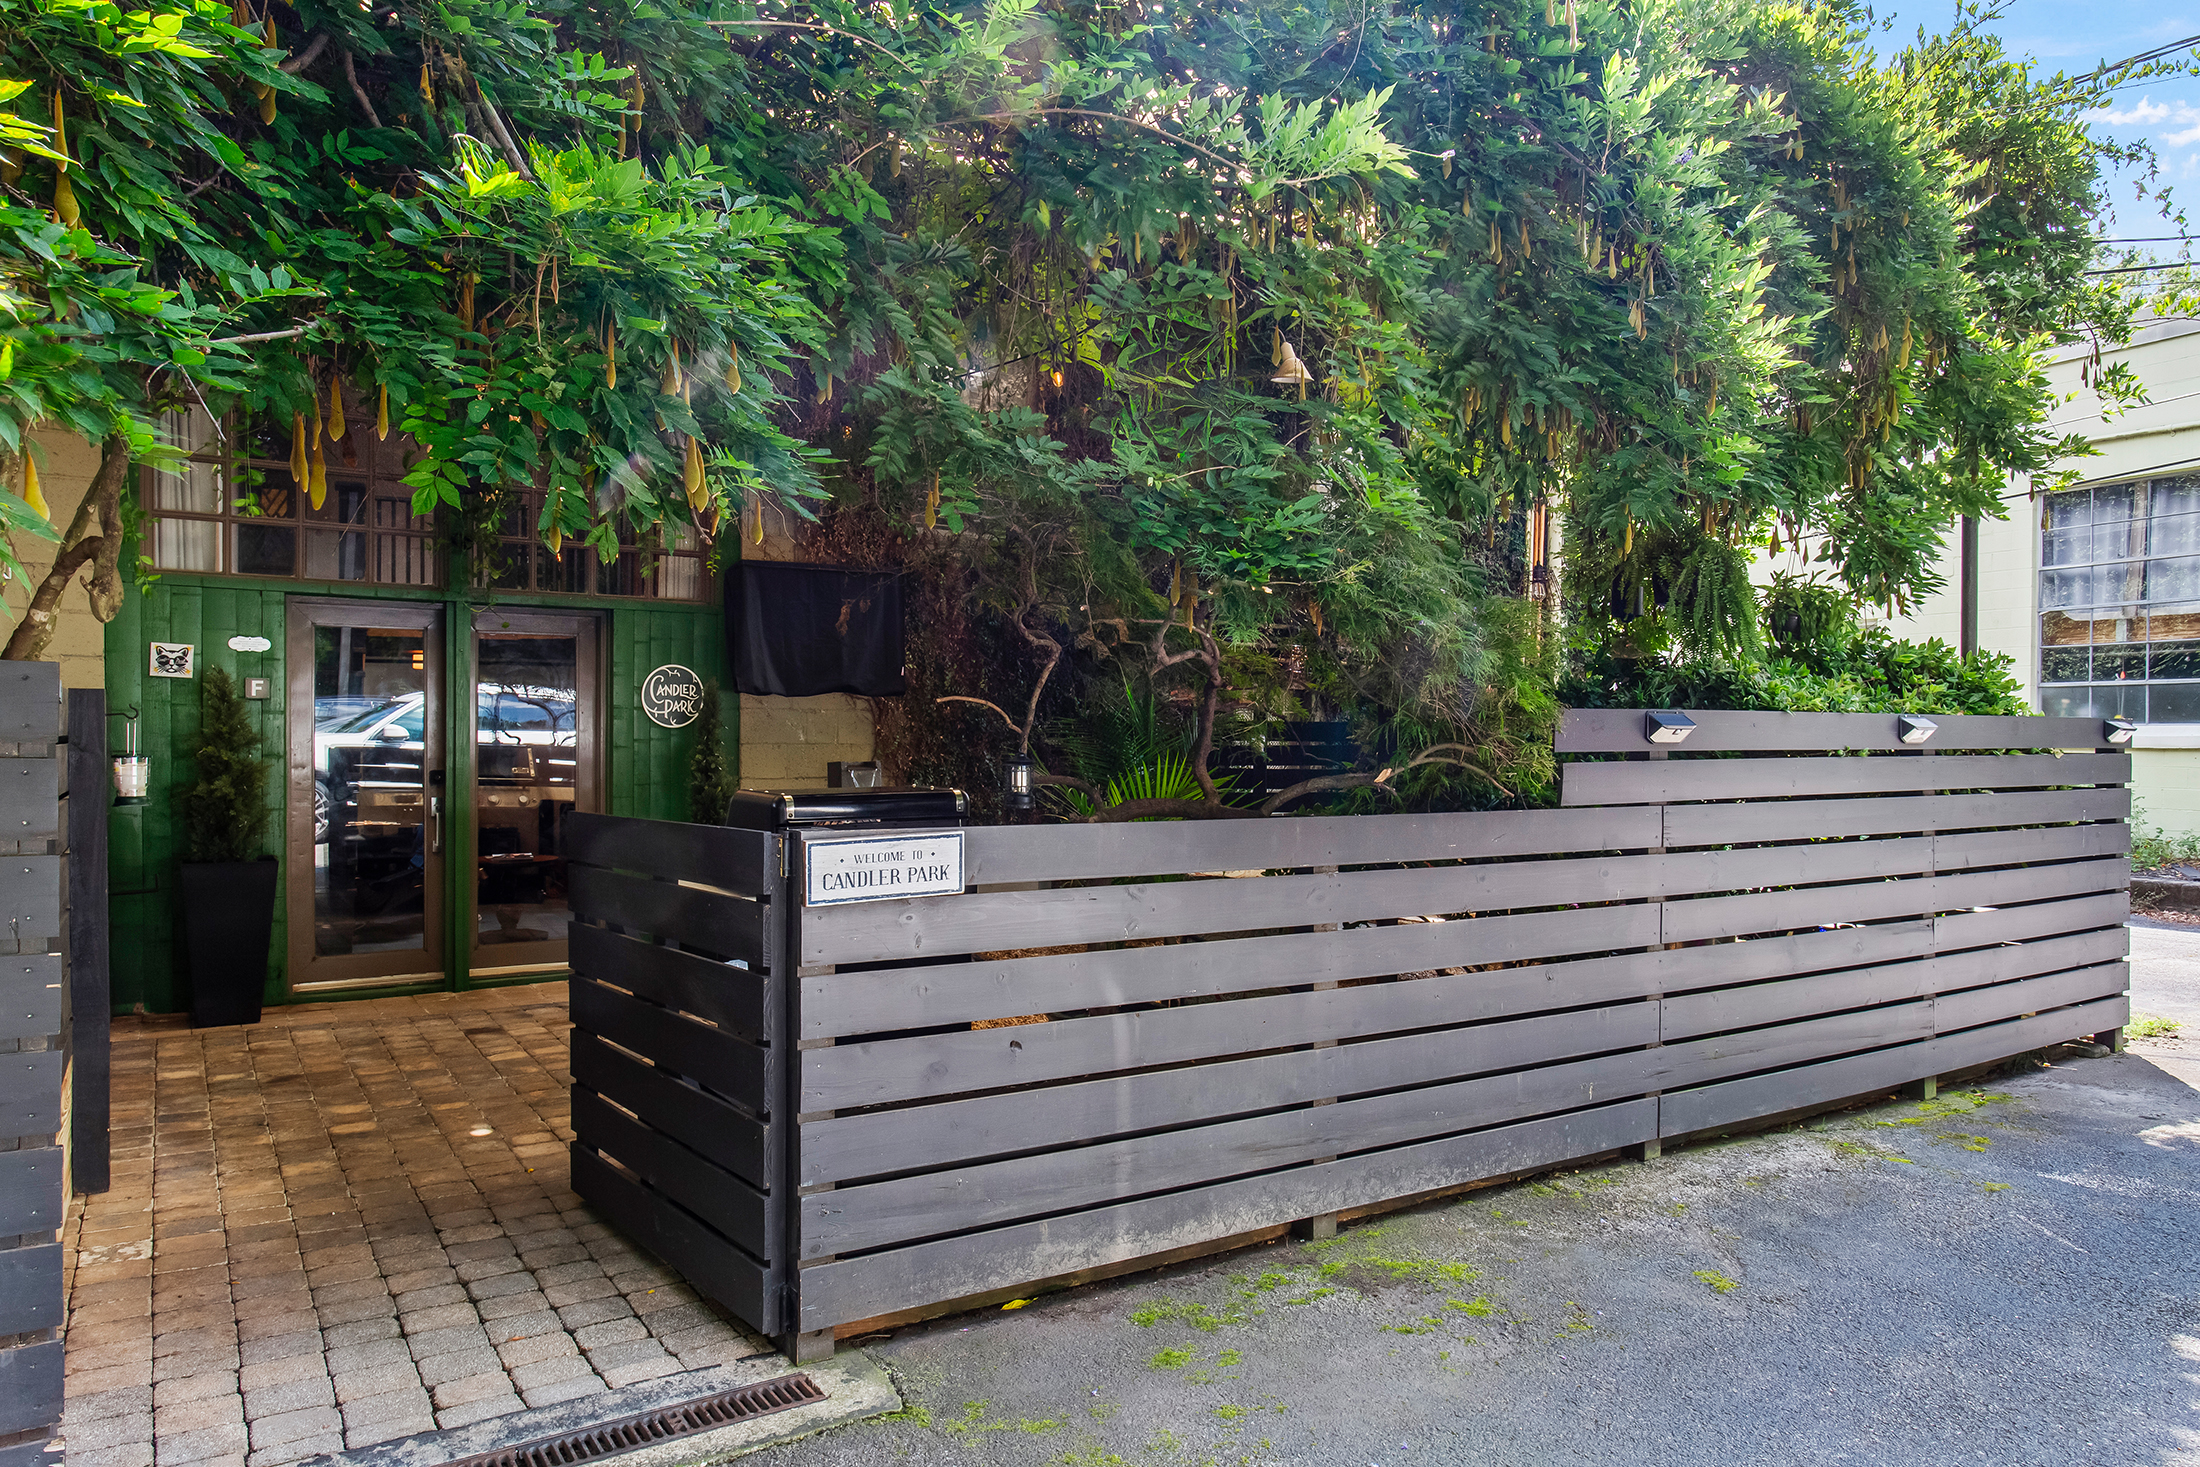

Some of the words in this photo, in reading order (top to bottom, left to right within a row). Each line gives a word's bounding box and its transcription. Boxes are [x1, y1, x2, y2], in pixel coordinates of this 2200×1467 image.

[251, 680, 264, 696] F
[650, 675, 699, 704] CANDLER
[664, 699, 698, 719] PARK
[853, 851, 905, 864] WELCOME
[912, 850, 923, 860] TO
[822, 868, 901, 891] CANDLER
[907, 864, 950, 883] PARK
